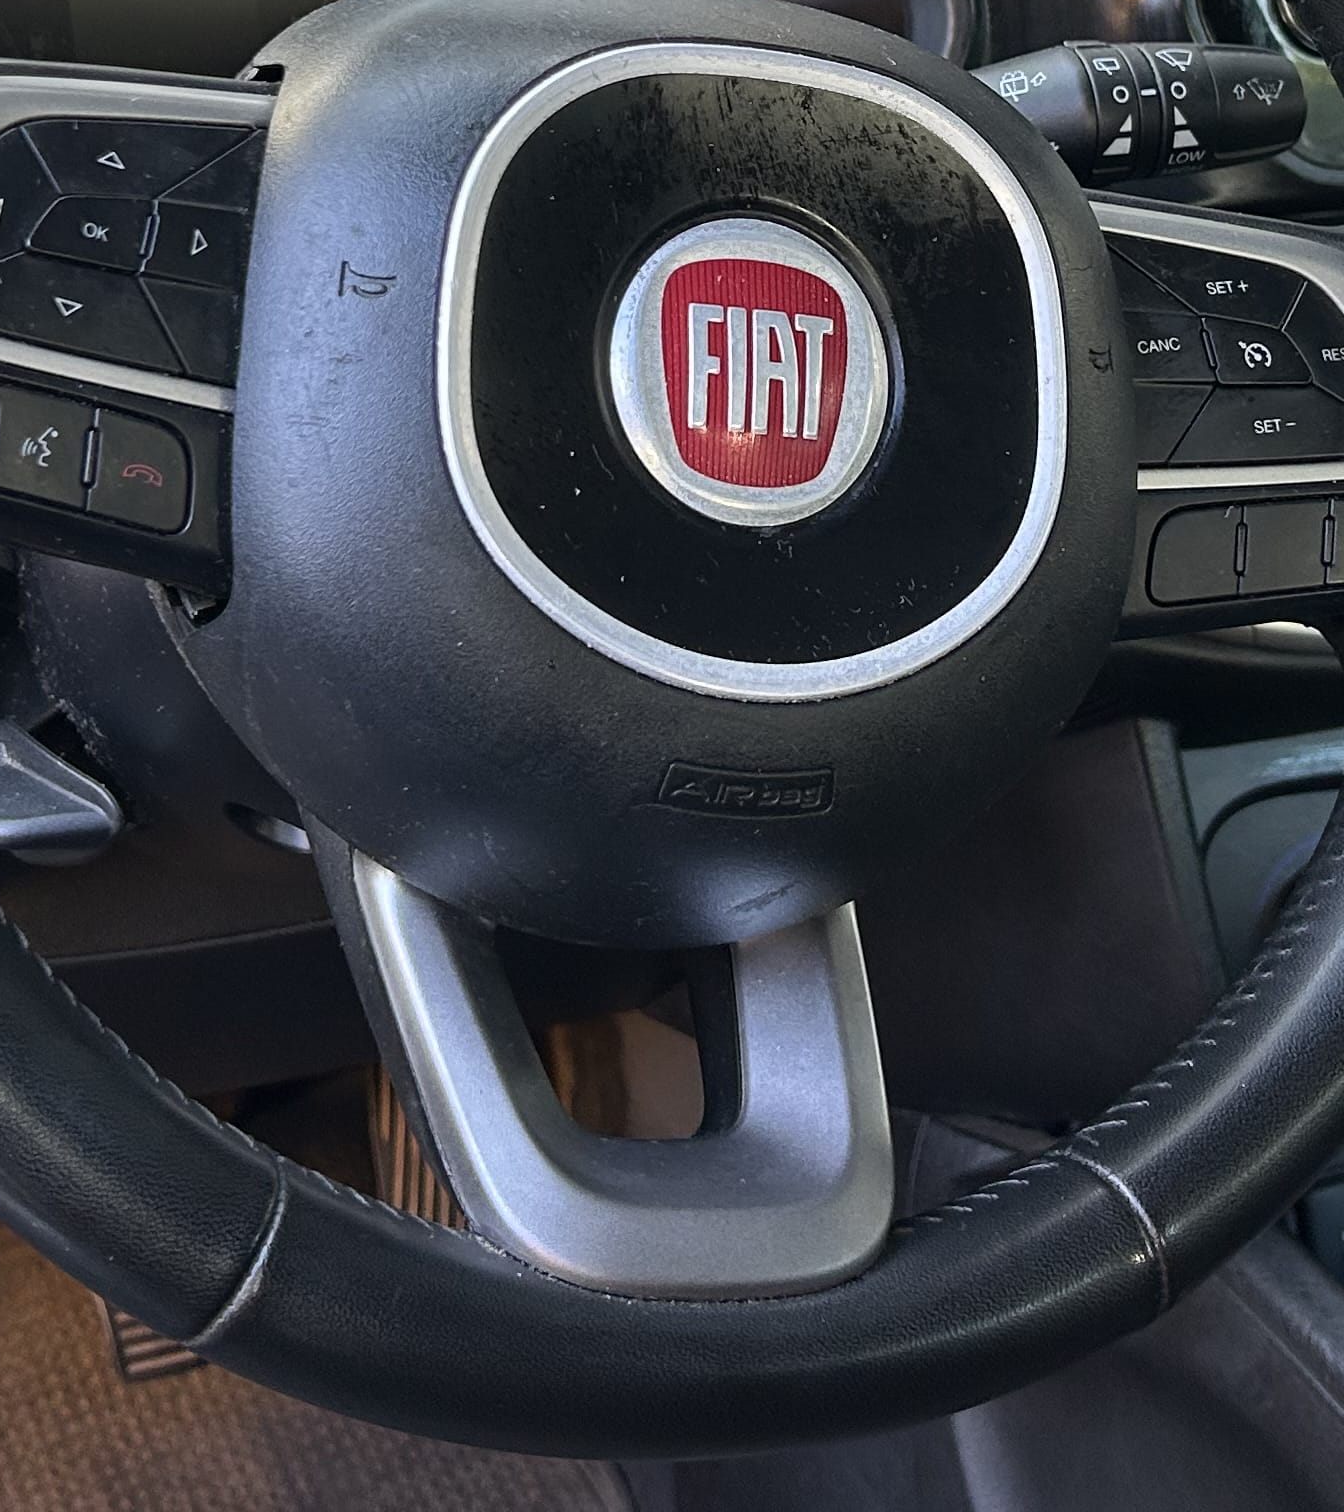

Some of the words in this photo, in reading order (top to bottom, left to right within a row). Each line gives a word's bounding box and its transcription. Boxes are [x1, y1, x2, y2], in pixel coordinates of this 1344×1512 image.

[1168, 150, 1206, 165] LOW
[83, 222, 110, 242] OK
[1206, 281, 1234, 295] SET
[1137, 337, 1182, 355] CANC
[687, 302, 834, 440] FIAT
[1253, 419, 1281, 434] SET
